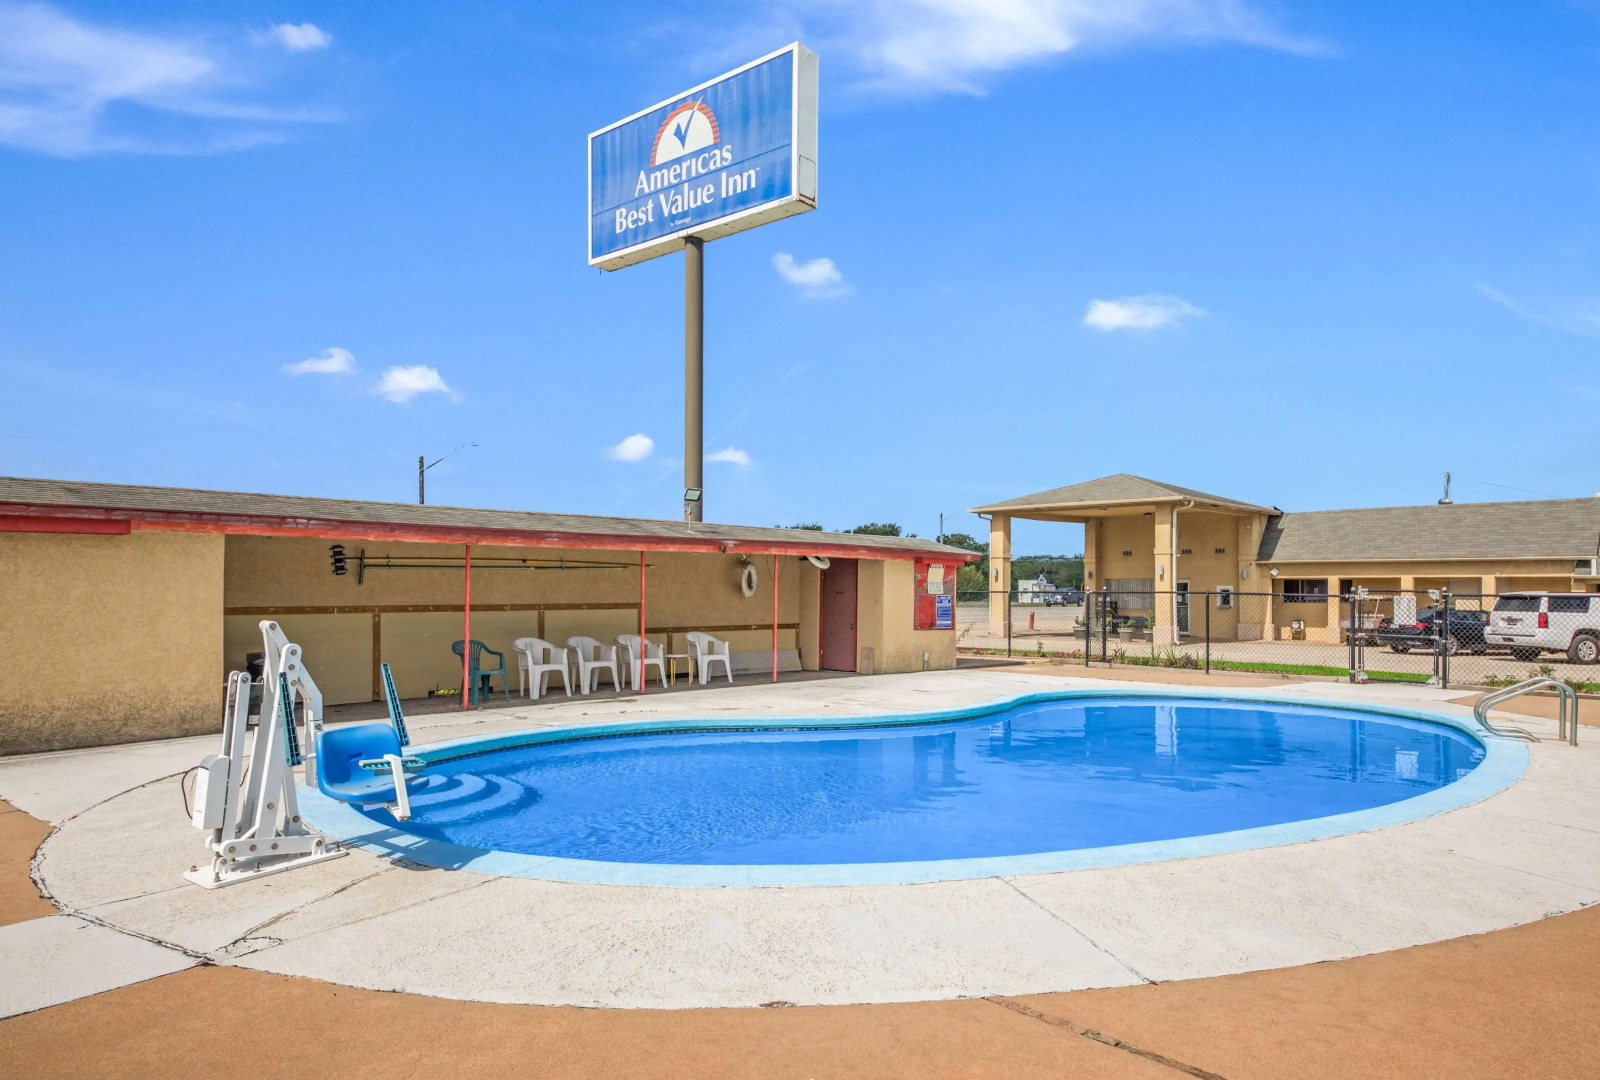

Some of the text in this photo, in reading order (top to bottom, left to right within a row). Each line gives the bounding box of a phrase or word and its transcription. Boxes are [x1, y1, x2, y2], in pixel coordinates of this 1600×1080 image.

[635, 144, 732, 197] Americas
[615, 199, 654, 234] Best
[659, 183, 715, 218] Value
